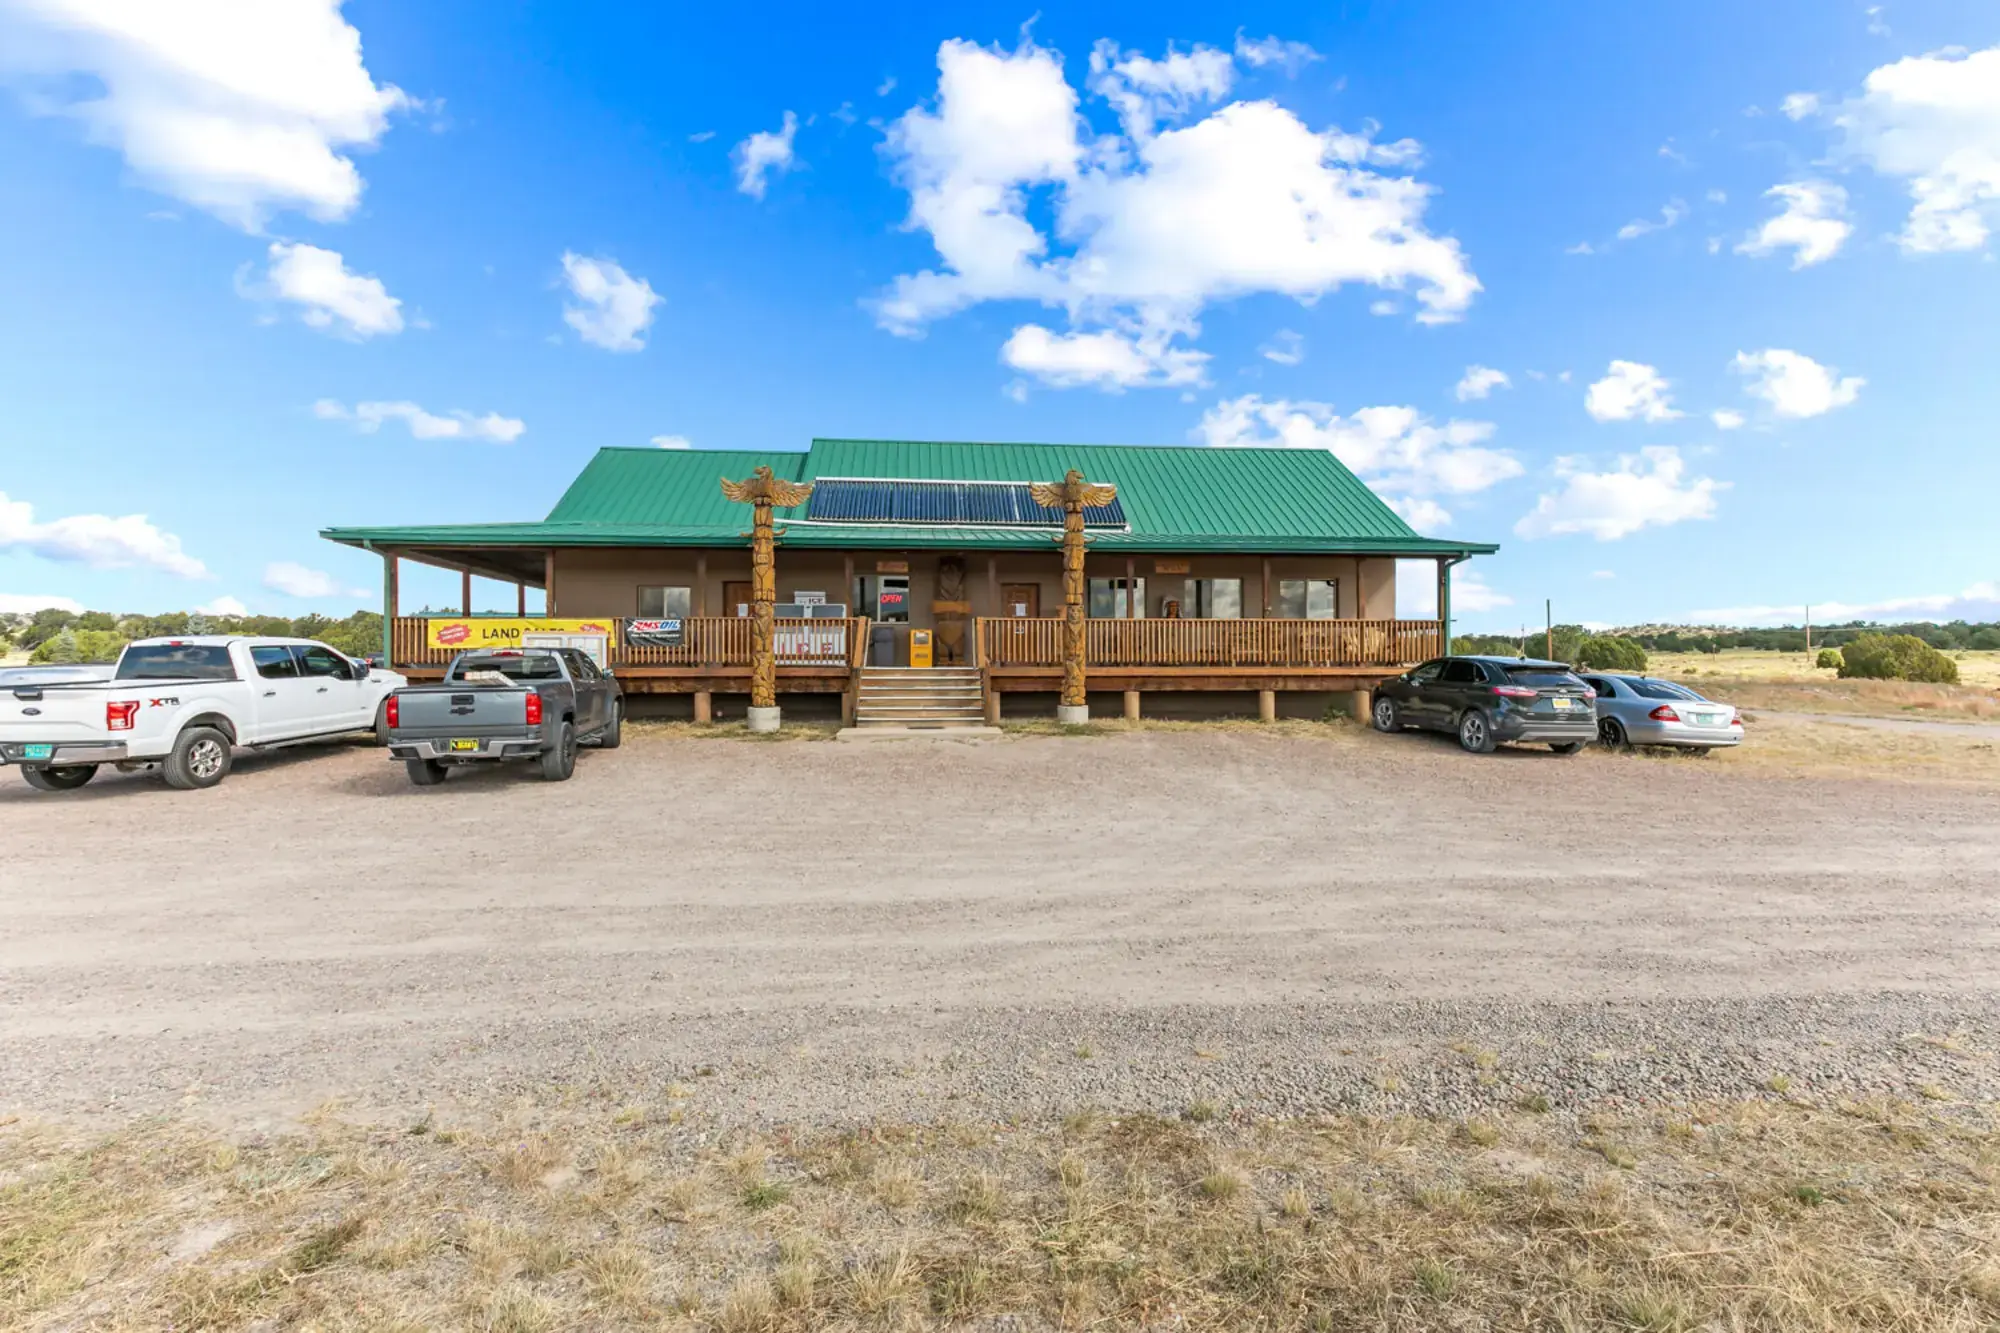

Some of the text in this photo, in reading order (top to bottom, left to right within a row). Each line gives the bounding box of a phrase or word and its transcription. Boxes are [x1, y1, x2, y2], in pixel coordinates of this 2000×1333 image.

[881, 594, 902, 604] OPEN
[633, 620, 679, 631] AMSOIL
[482, 628, 520, 640] LAND
